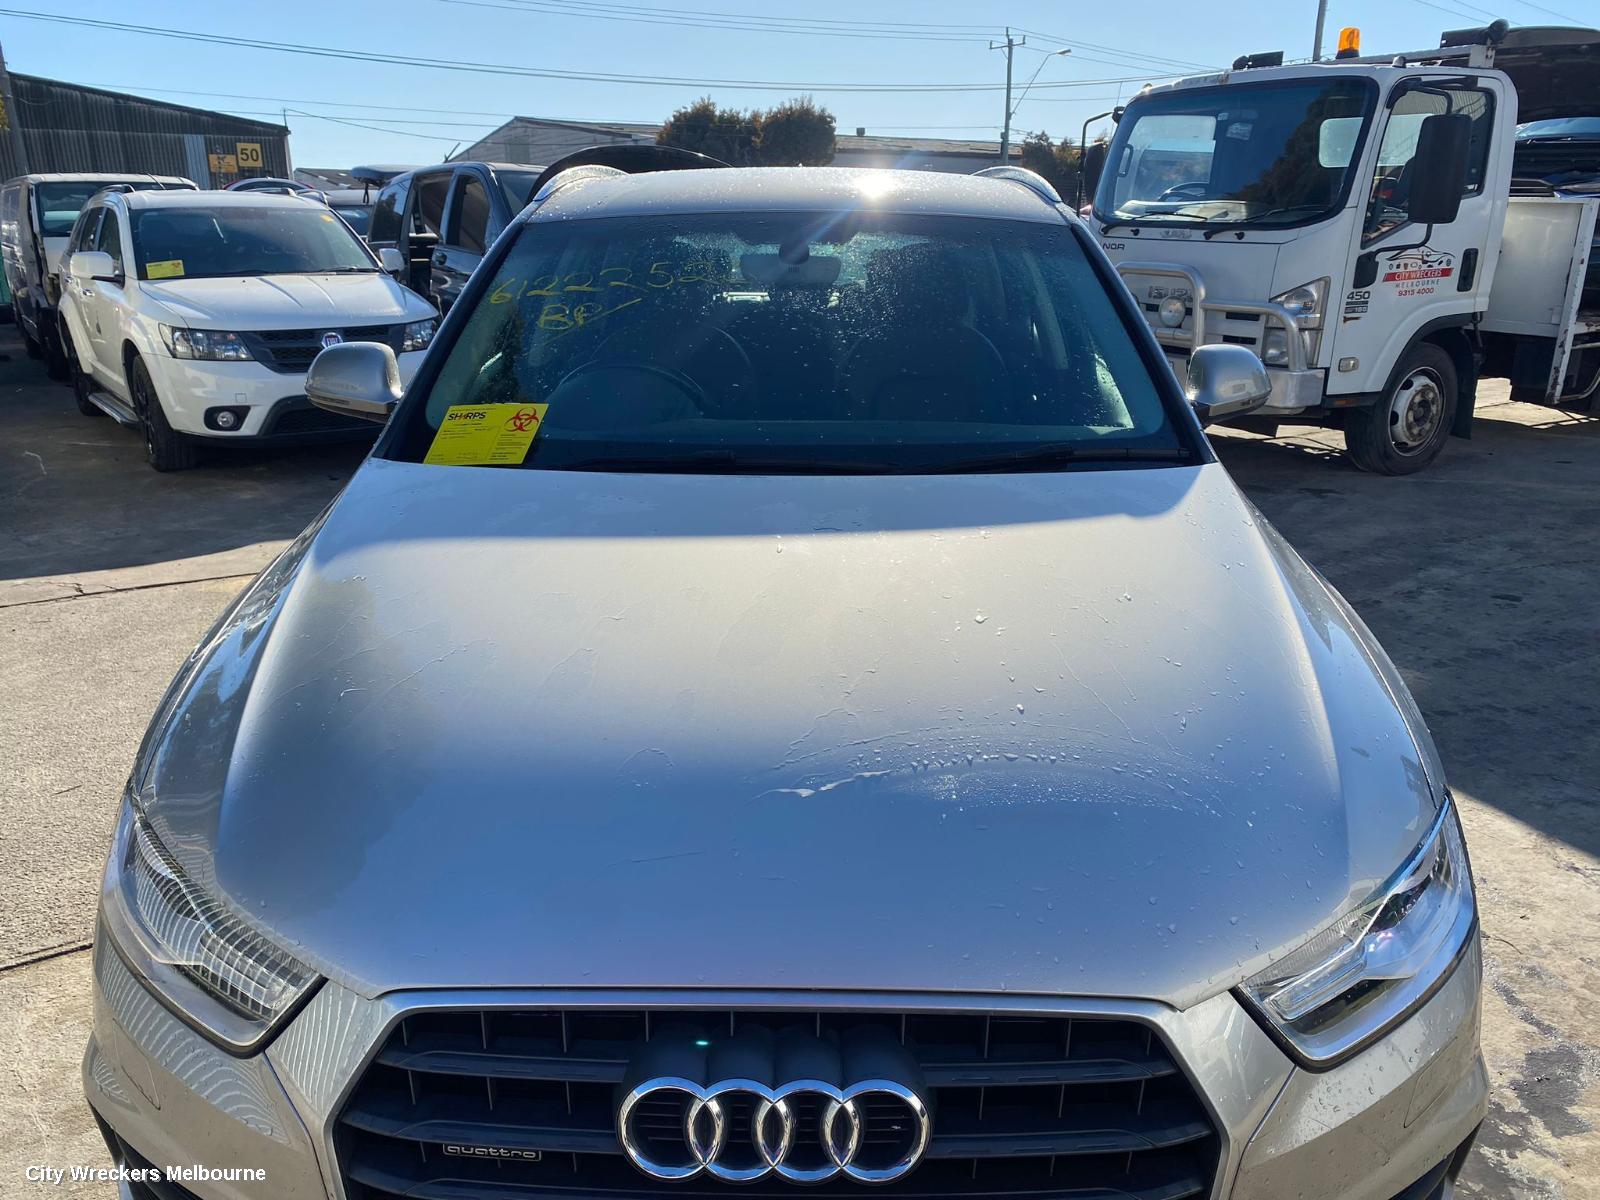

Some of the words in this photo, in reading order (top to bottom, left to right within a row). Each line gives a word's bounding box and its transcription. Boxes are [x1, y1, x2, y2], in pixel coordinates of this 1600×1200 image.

[240, 148, 259, 162] 50
[1395, 272, 1409, 281] CITY
[1410, 269, 1442, 279] WRECKERS
[1395, 279, 1440, 289] MELBOURNE
[1347, 291, 1370, 300] 450
[1398, 289, 1416, 297] 9315
[1416, 287, 1435, 295] 4000
[447, 411, 487, 421] SHARPS
[447, 1145, 537, 1159] quattro
